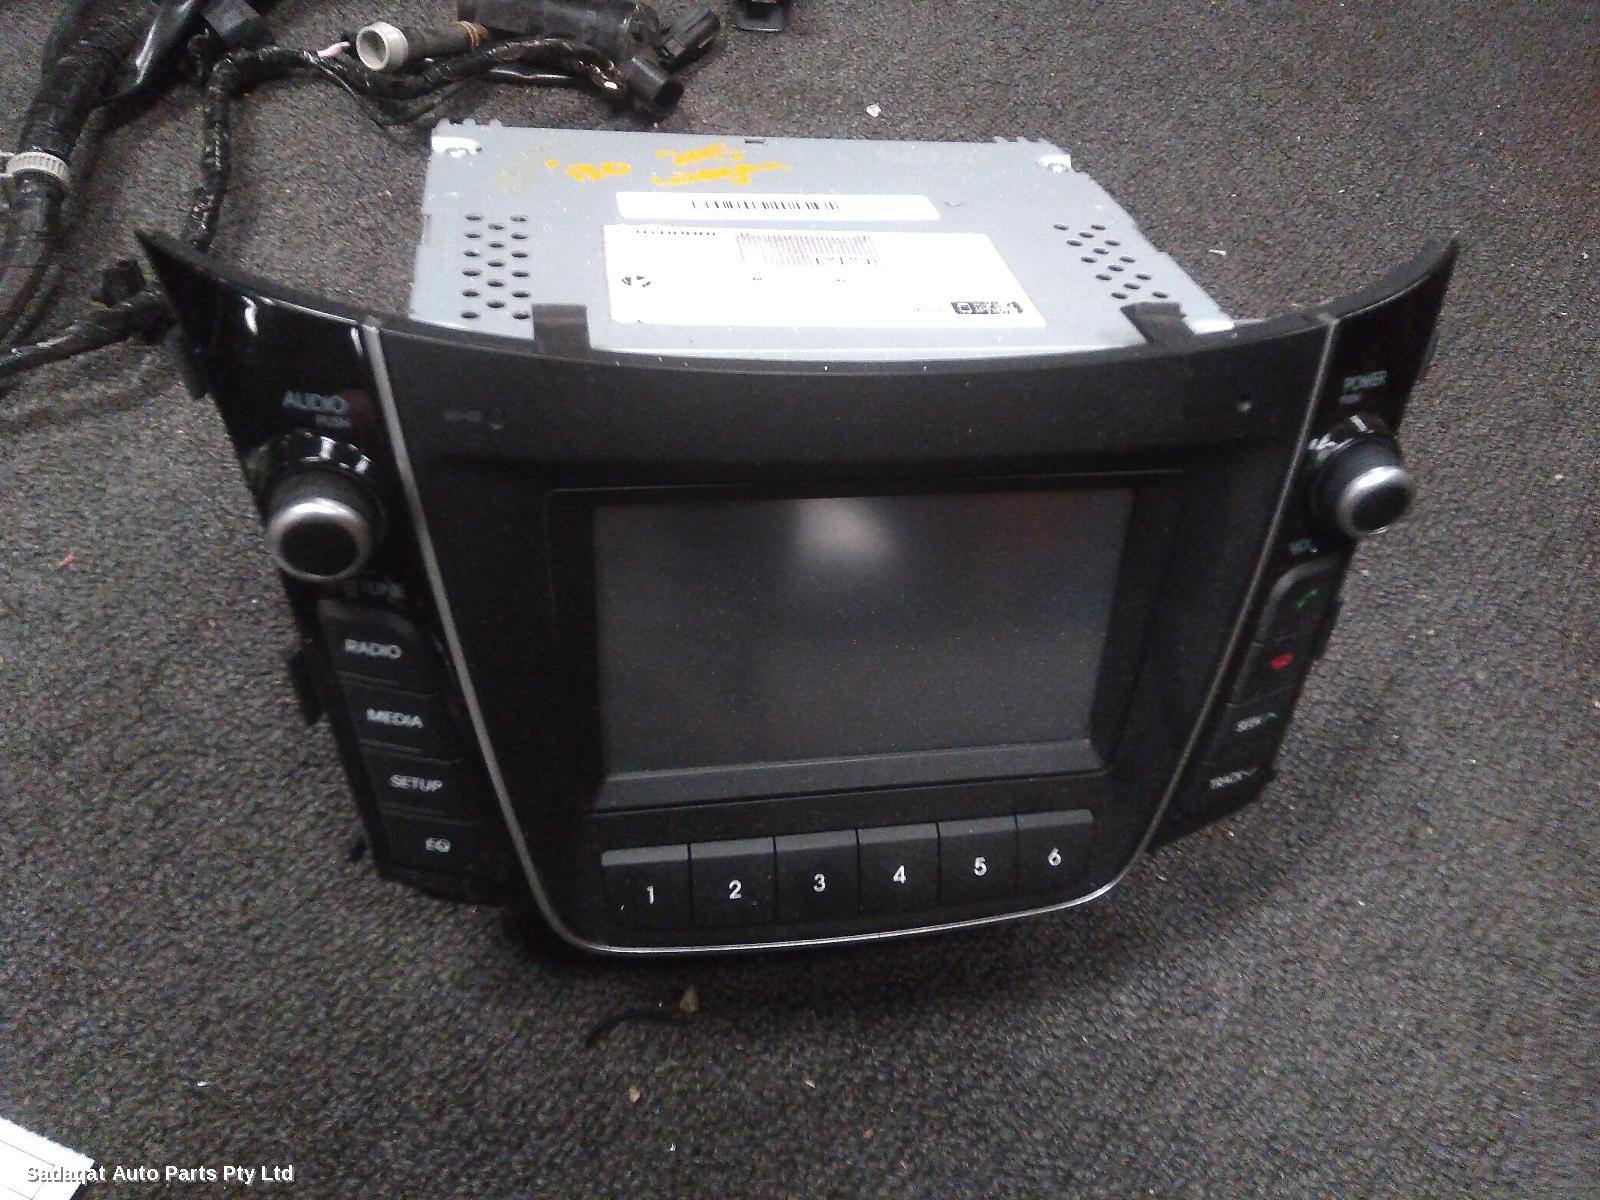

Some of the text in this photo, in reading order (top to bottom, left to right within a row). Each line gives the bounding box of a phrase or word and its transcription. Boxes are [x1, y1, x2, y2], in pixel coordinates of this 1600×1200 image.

[282, 391, 348, 415] AUDIO
[345, 639, 402, 659] RADIO
[367, 708, 424, 728] MEDIA
[390, 774, 443, 792] SETUP
[646, 847, 1062, 904] 1 2 3 4 5 6
